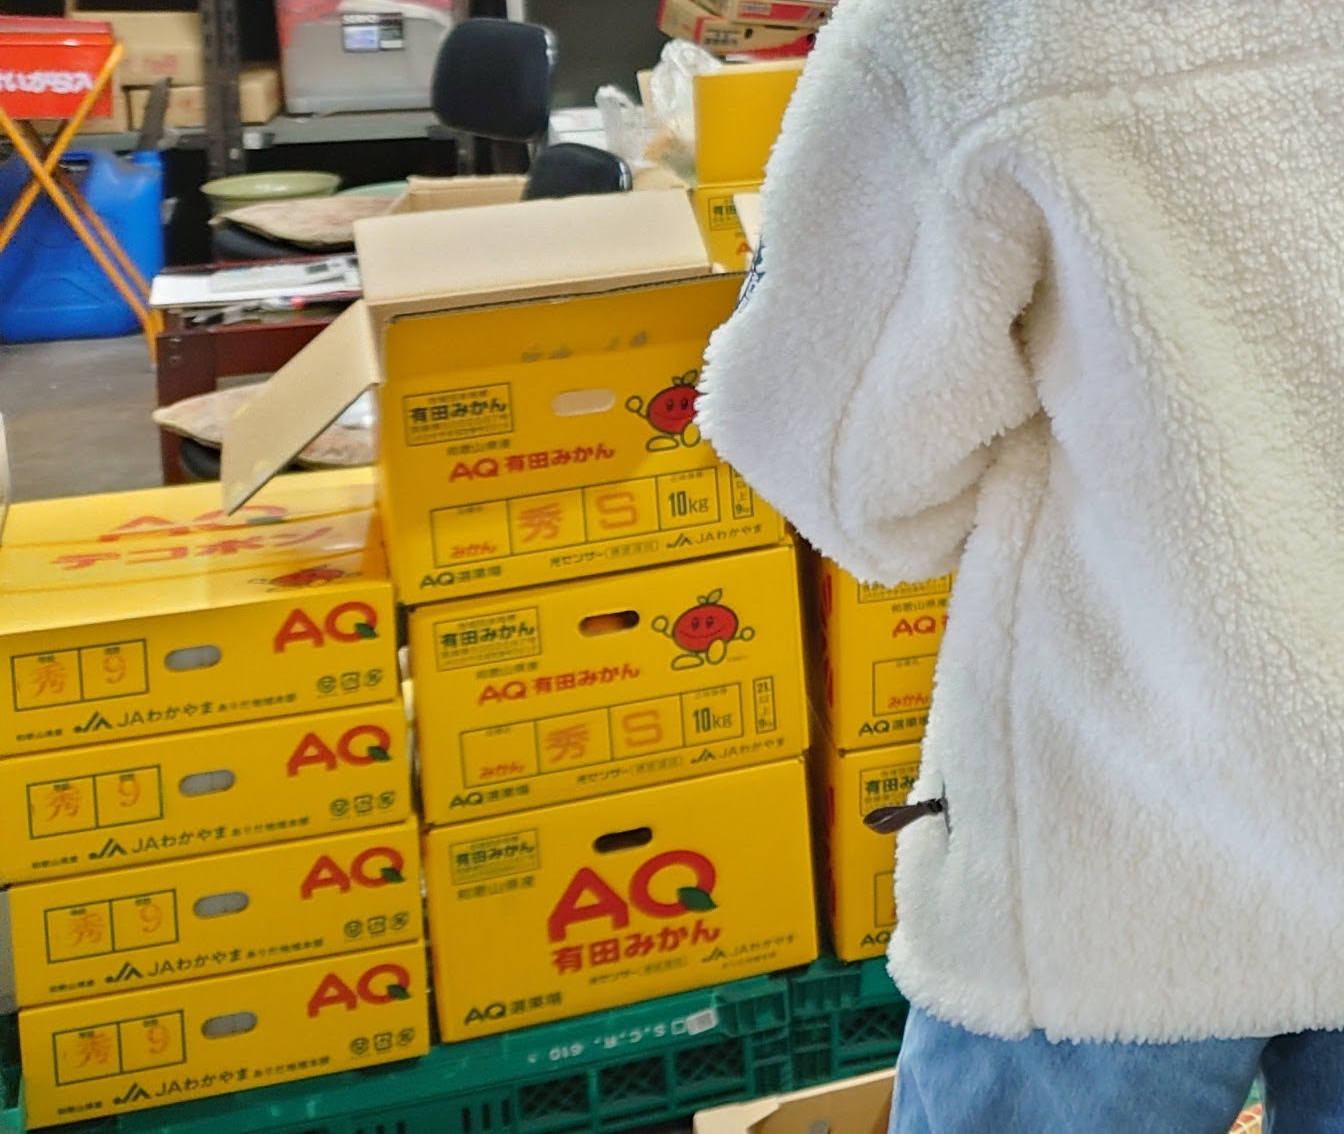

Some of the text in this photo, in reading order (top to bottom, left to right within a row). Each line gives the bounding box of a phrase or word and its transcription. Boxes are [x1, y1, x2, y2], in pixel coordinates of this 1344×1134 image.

[409, 397, 507, 423] 有田みかん
[449, 442, 617, 483] AQ 有田みかん
[449, 489, 709, 560] みかん 秀 S 10kg
[51, 526, 333, 571] デコポン
[419, 569, 456, 590] AQ
[694, 523, 763, 546] JAわかやま
[273, 601, 379, 654] AQ
[439, 621, 536, 650] 有田みかん
[892, 615, 937, 638] AQ
[31, 655, 128, 698] 秀 9
[478, 663, 641, 706] AQ 有田みかん
[117, 701, 215, 728] JAわかやま
[858, 719, 891, 737] AQ
[285, 724, 393, 778] AQ
[479, 706, 733, 780] みかん 秀 S 10kg
[449, 789, 485, 809] AQ
[719, 737, 785, 761] JAわかやま
[46, 774, 142, 823] 秀 9
[131, 826, 230, 855] JAわかやま
[456, 841, 535, 866] 有田みかん
[300, 845, 406, 900] AQ
[547, 849, 718, 942] AQ
[68, 902, 163, 947] 秀 9
[861, 931, 891, 946] AQ
[148, 947, 243, 977] JAわかやま
[549, 919, 721, 976] 有田みかん
[307, 963, 412, 1018] AQ
[464, 1002, 507, 1025] AQ
[77, 1023, 171, 1066] 秀 9
[155, 1067, 249, 1098] JAわかやま
